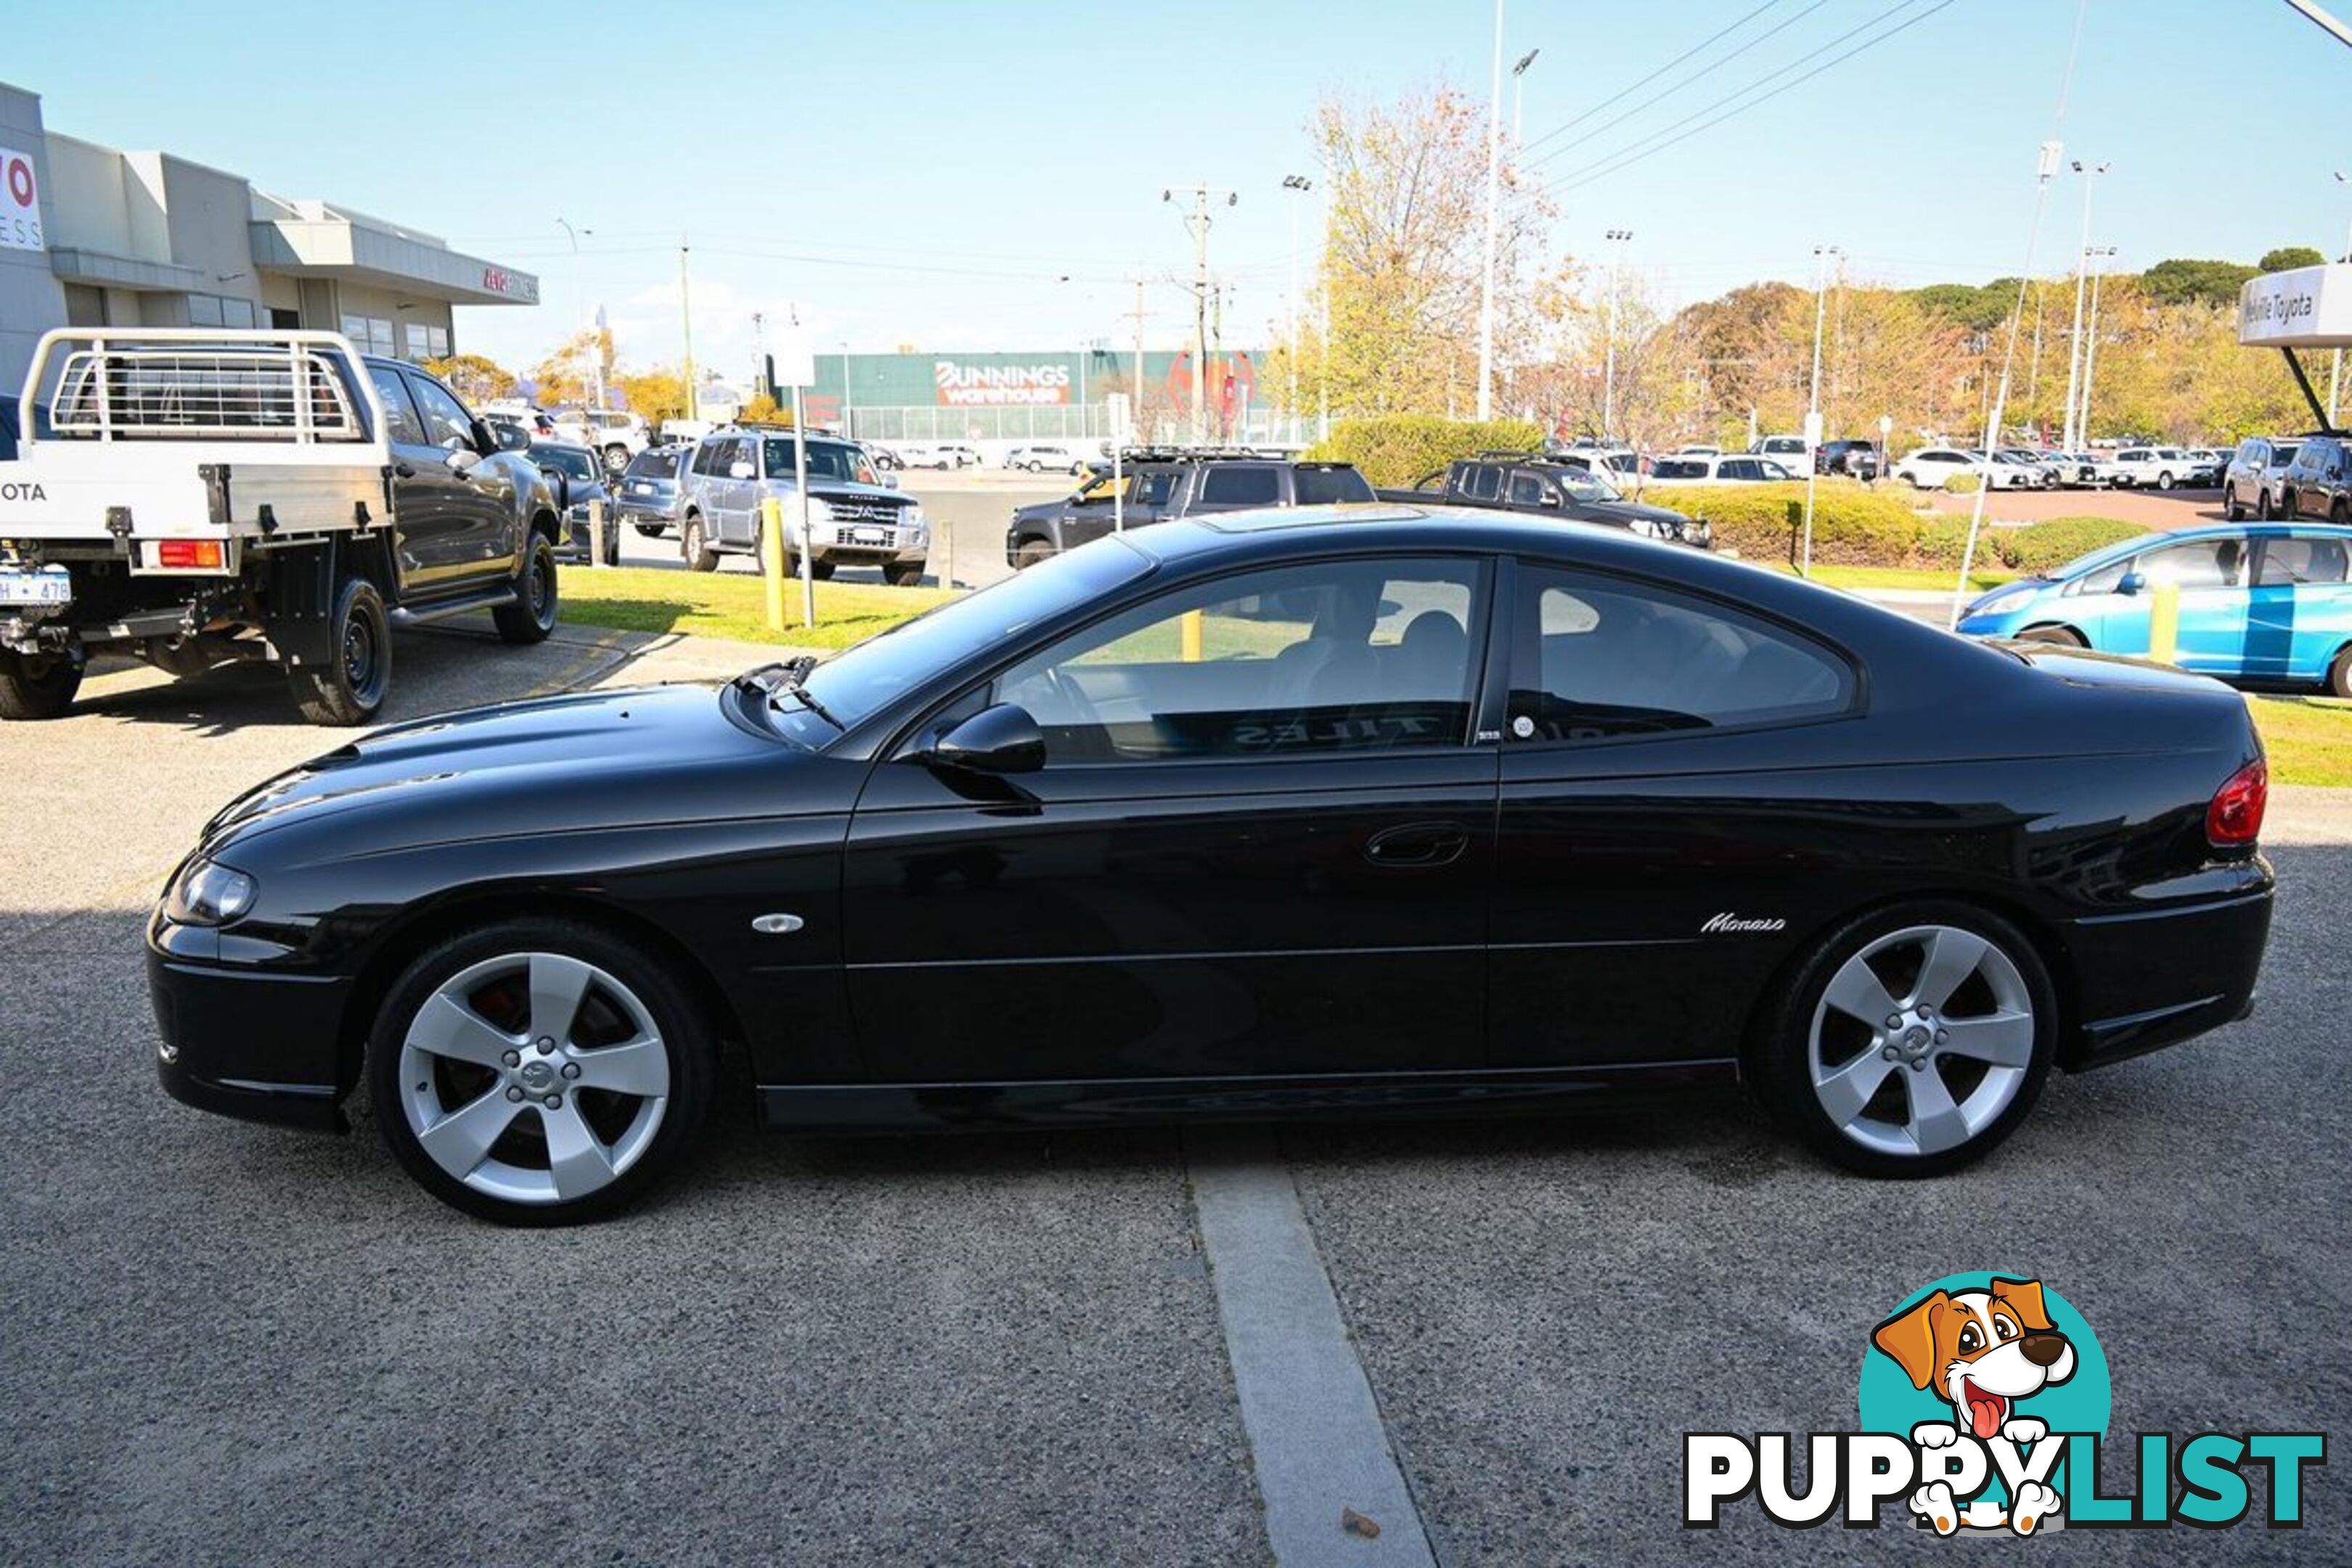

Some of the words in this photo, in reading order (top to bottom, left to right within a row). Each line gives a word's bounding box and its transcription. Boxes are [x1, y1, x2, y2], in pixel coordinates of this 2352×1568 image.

[0, 155, 33, 208] O
[2273, 293, 2312, 325] Toyota
[935, 361, 1069, 387] BUNNINGS
[1, 483, 46, 501] OTA
[41, 582, 70, 600] 478
